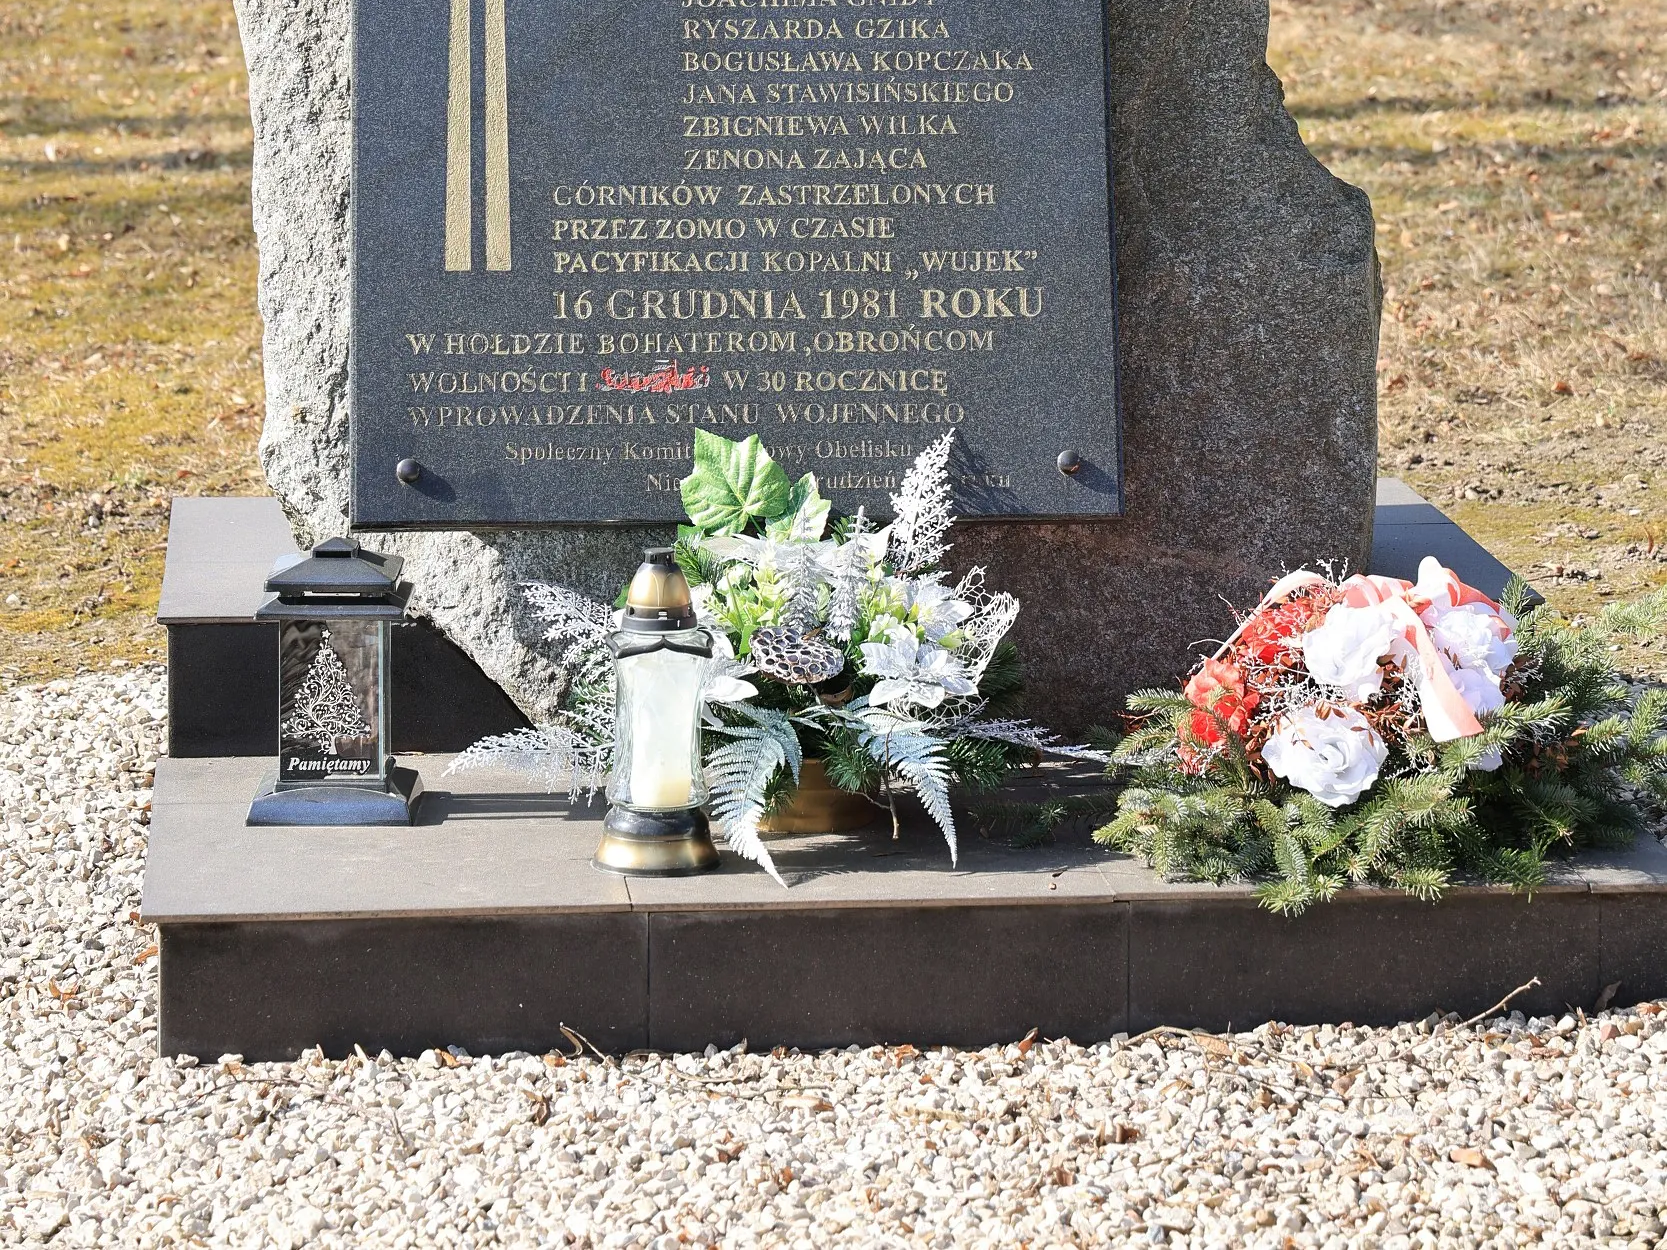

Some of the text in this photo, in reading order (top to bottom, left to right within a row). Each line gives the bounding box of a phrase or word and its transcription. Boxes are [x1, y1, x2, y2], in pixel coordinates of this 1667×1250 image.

[682, 18, 951, 40] RYSZARDA GZIKA
[681, 50, 1034, 72] BOGUSŁAWA KOPCZAKA
[682, 77, 1014, 105] JANA STAWISIŃSKIEGO
[682, 114, 959, 138] ZBIGNIEWA WILKA
[683, 148, 928, 174] ZENONA ZAJĄCA
[553, 179, 996, 206] GÓRNIKÓW ZASTRZELONYCH
[551, 216, 895, 240] PRZEZ ZOMO W CZASIE
[553, 251, 750, 273] PACYFIKACJI
[761, 250, 893, 272] KOPALNI
[552, 286, 1045, 320] 16 GRUDNIA 1981 ROKU
[405, 333, 437, 355] W
[443, 333, 585, 355] HOŁDZIE
[406, 365, 571, 393] WOLNOŚCI
[578, 372, 589, 393] I
[722, 370, 750, 391] W
[756, 370, 787, 392] 30
[794, 370, 948, 396] ROCZNICĘ
[407, 403, 965, 427] WPROWADZENIA STANU WOJENNEGO
[504, 441, 615, 465] Społeczny
[623, 441, 692, 460] Komit
[815, 439, 911, 459] Obelisku
[815, 470, 896, 489] rudzień
[286, 756, 371, 774] Pamiętamy
